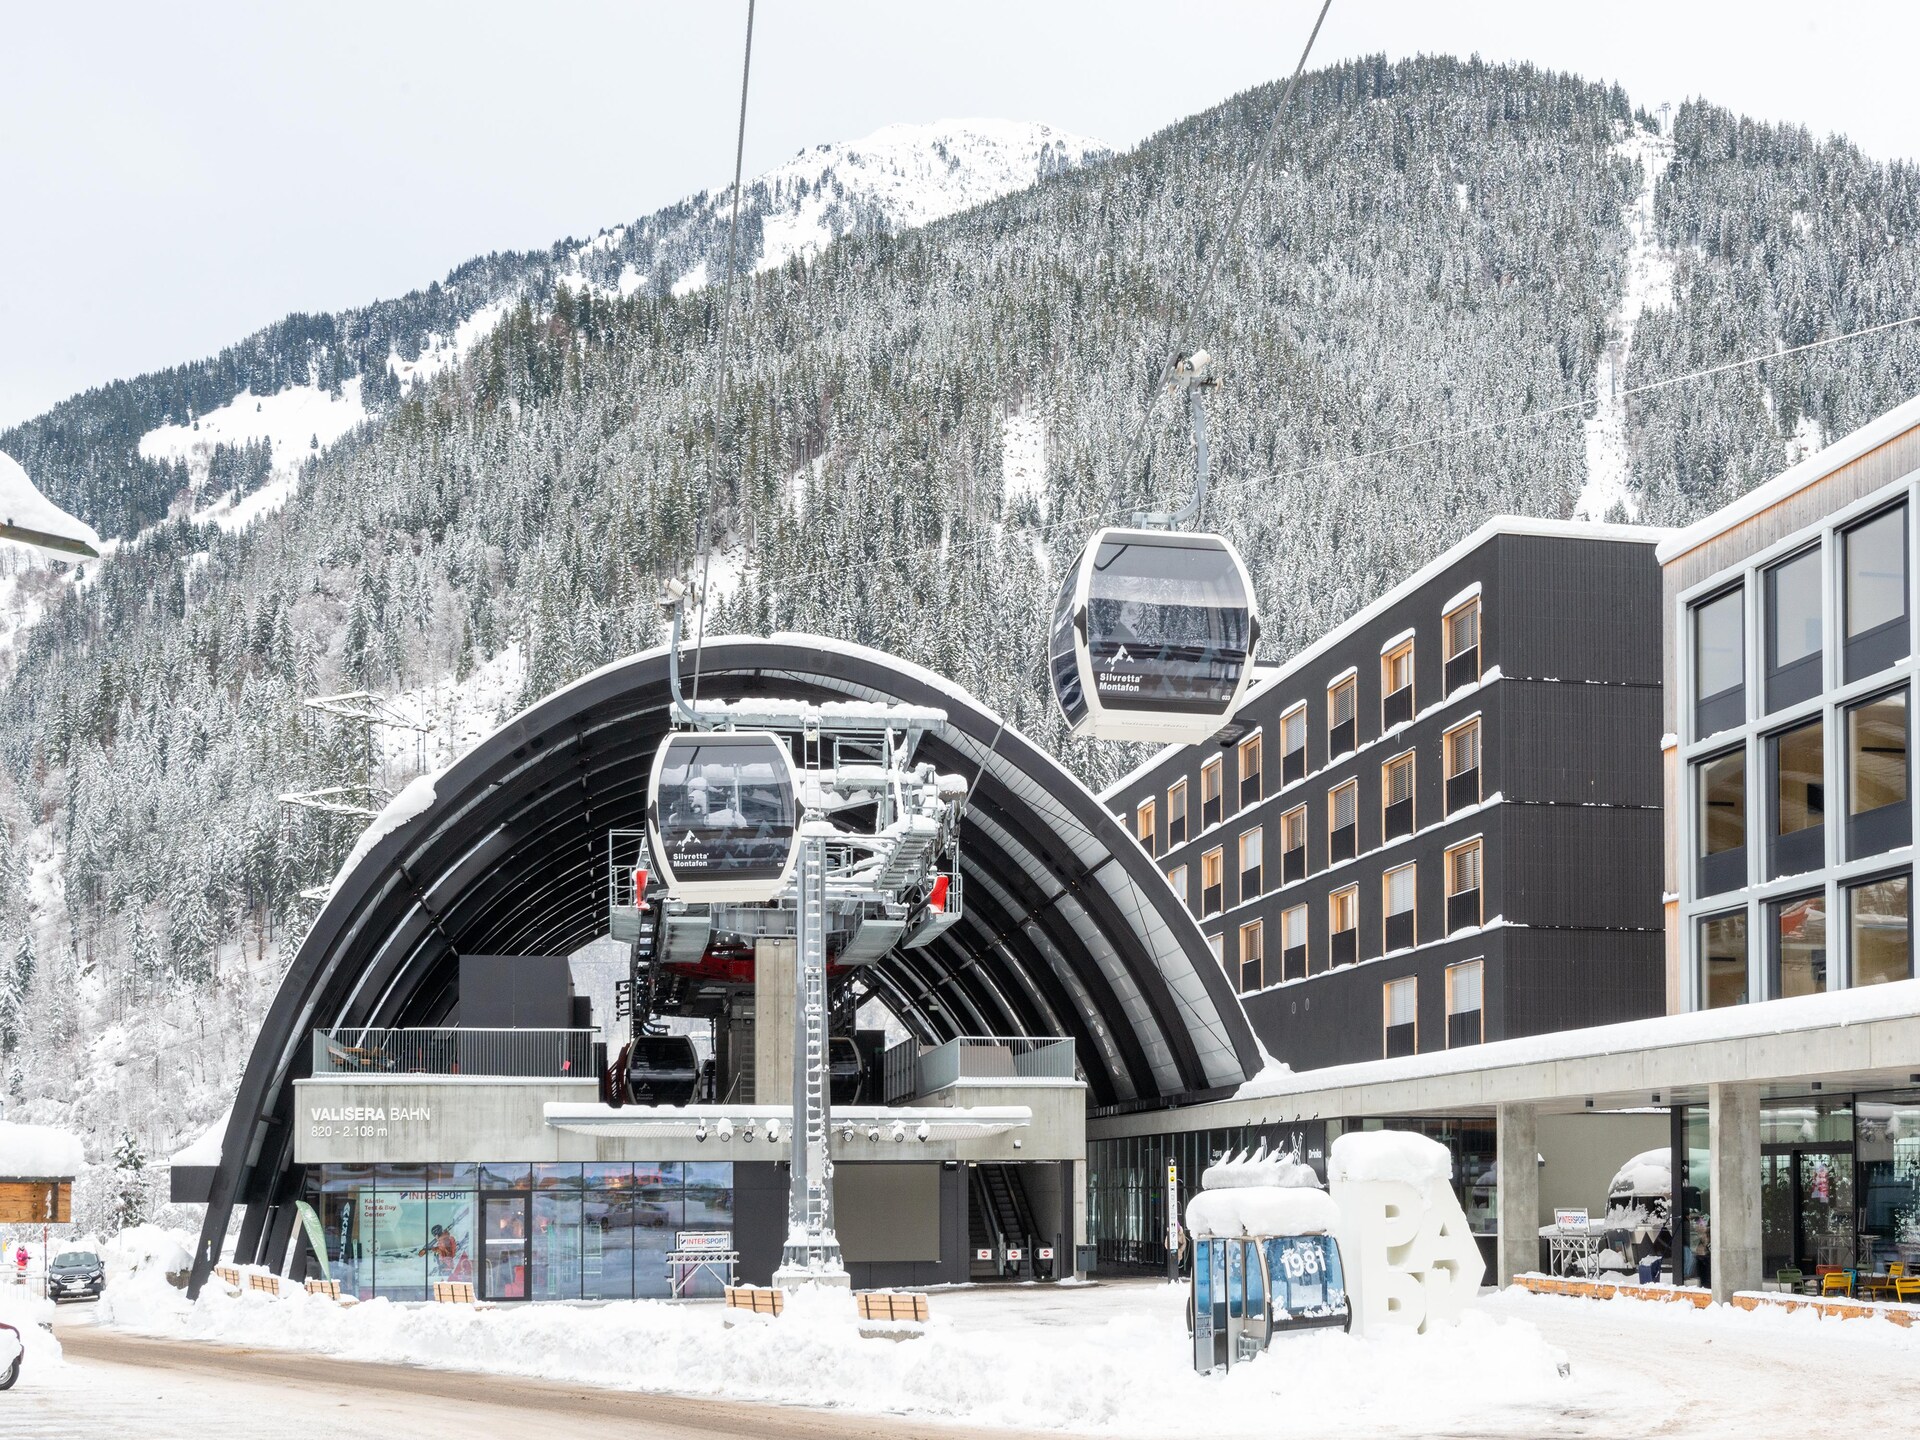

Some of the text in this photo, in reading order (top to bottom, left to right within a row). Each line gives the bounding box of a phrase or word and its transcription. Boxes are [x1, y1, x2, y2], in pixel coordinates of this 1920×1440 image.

[1099, 673, 1141, 682] Silvretta
[1099, 682, 1140, 692] Montafon
[311, 1107, 431, 1121] VALISERA BAHN
[311, 1126, 332, 1137] 820
[343, 1126, 374, 1137] 2.108
[377, 1127, 388, 1137] m
[1281, 1245, 1327, 1279] 1981
